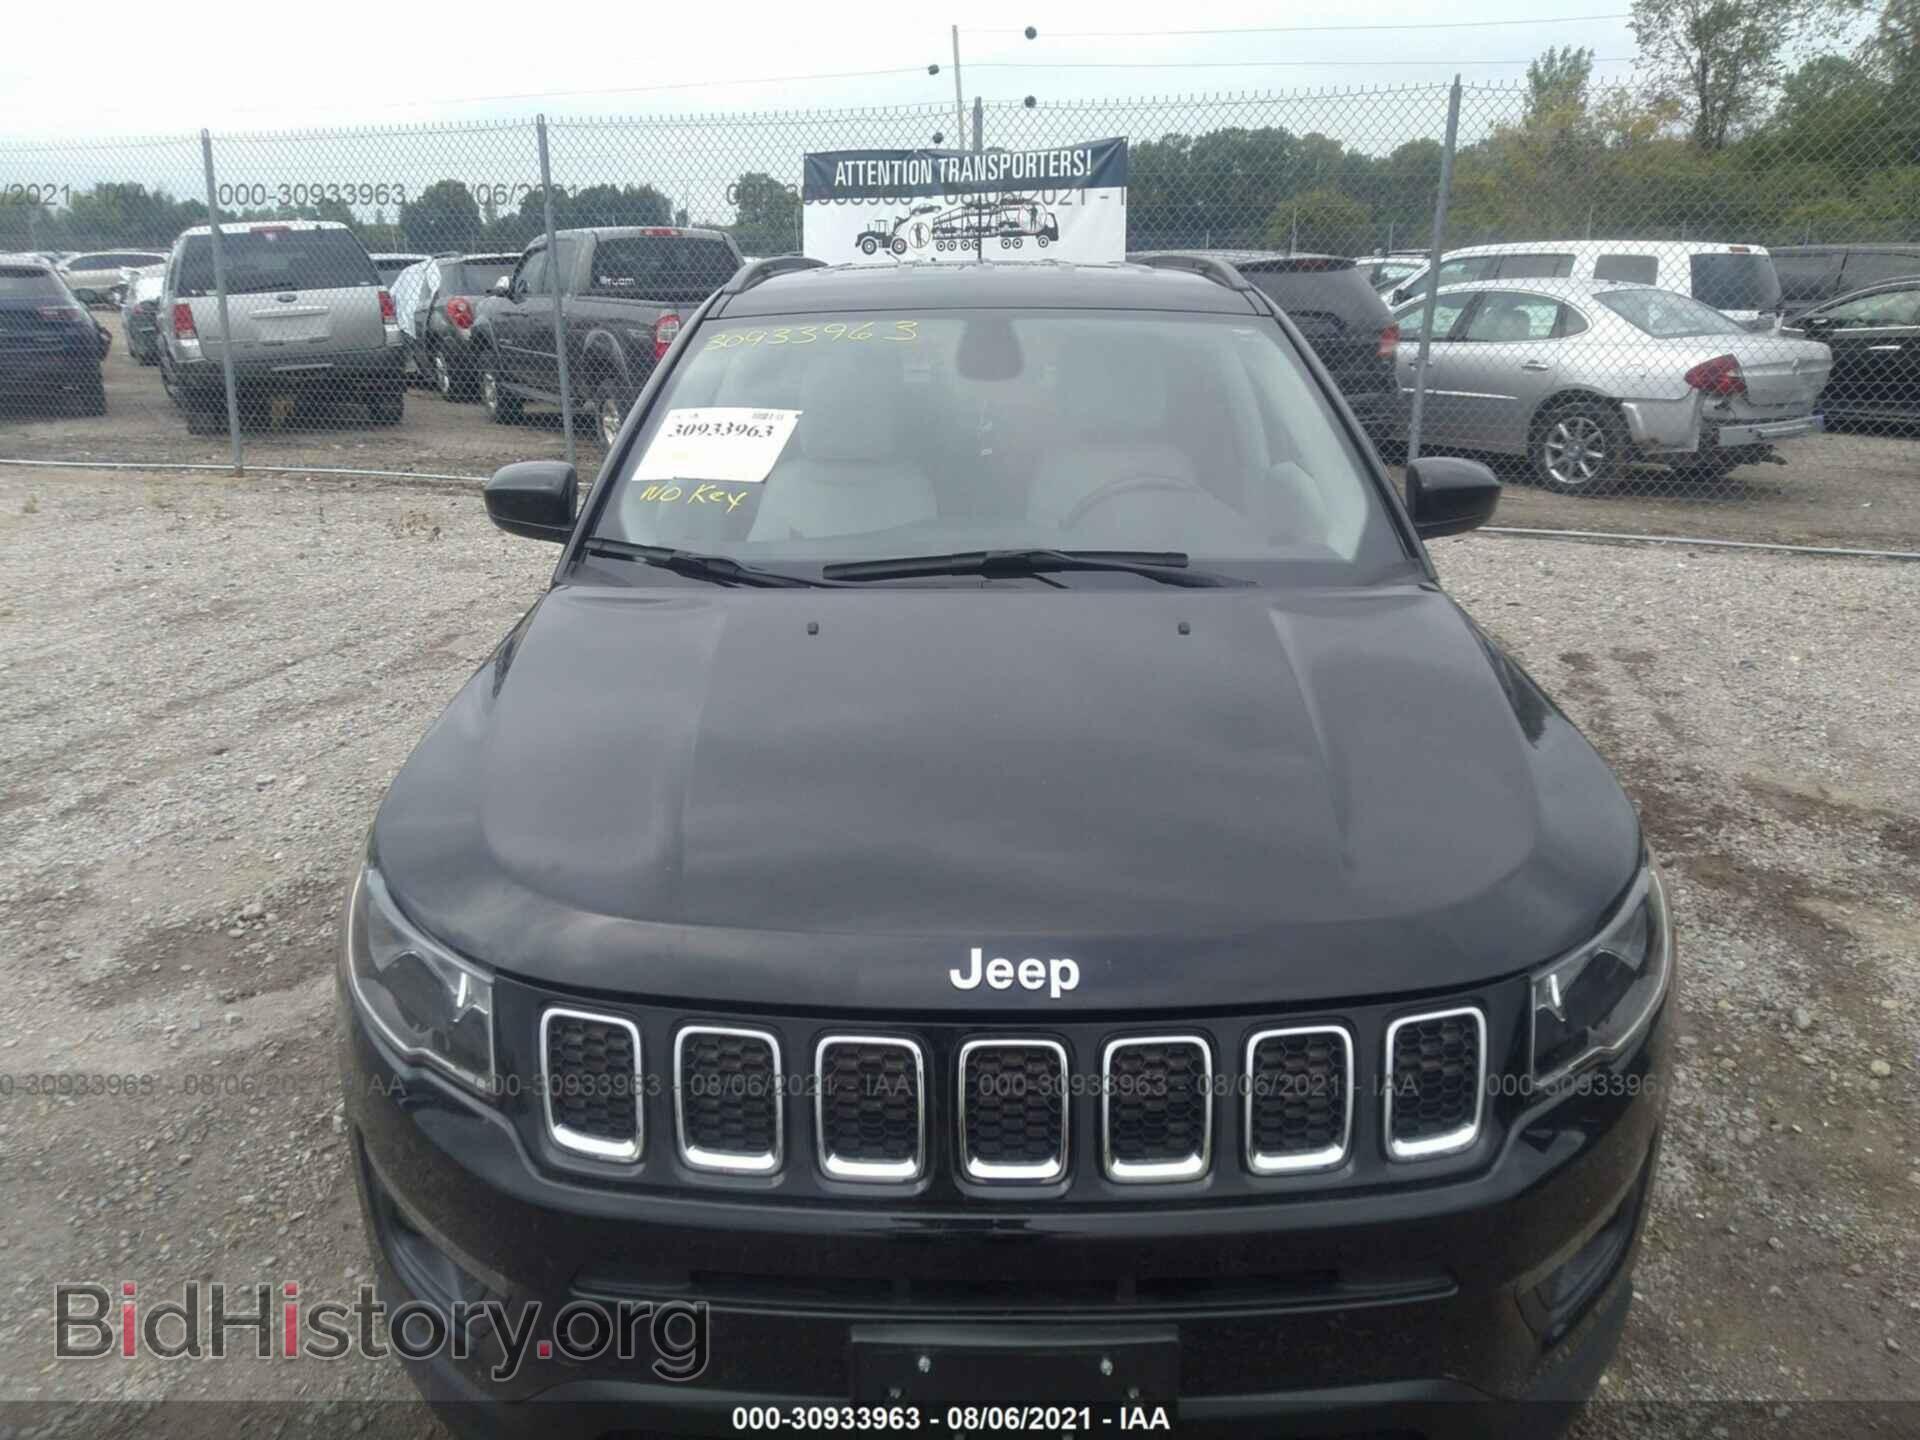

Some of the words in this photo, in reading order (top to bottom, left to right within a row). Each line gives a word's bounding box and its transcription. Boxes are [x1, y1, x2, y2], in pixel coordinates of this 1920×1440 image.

[834, 159, 933, 187] ATTENTION
[938, 149, 1093, 184] TRANSPORTERS!
[667, 421, 775, 438] 30933963
[950, 947, 1080, 999] Jeep
